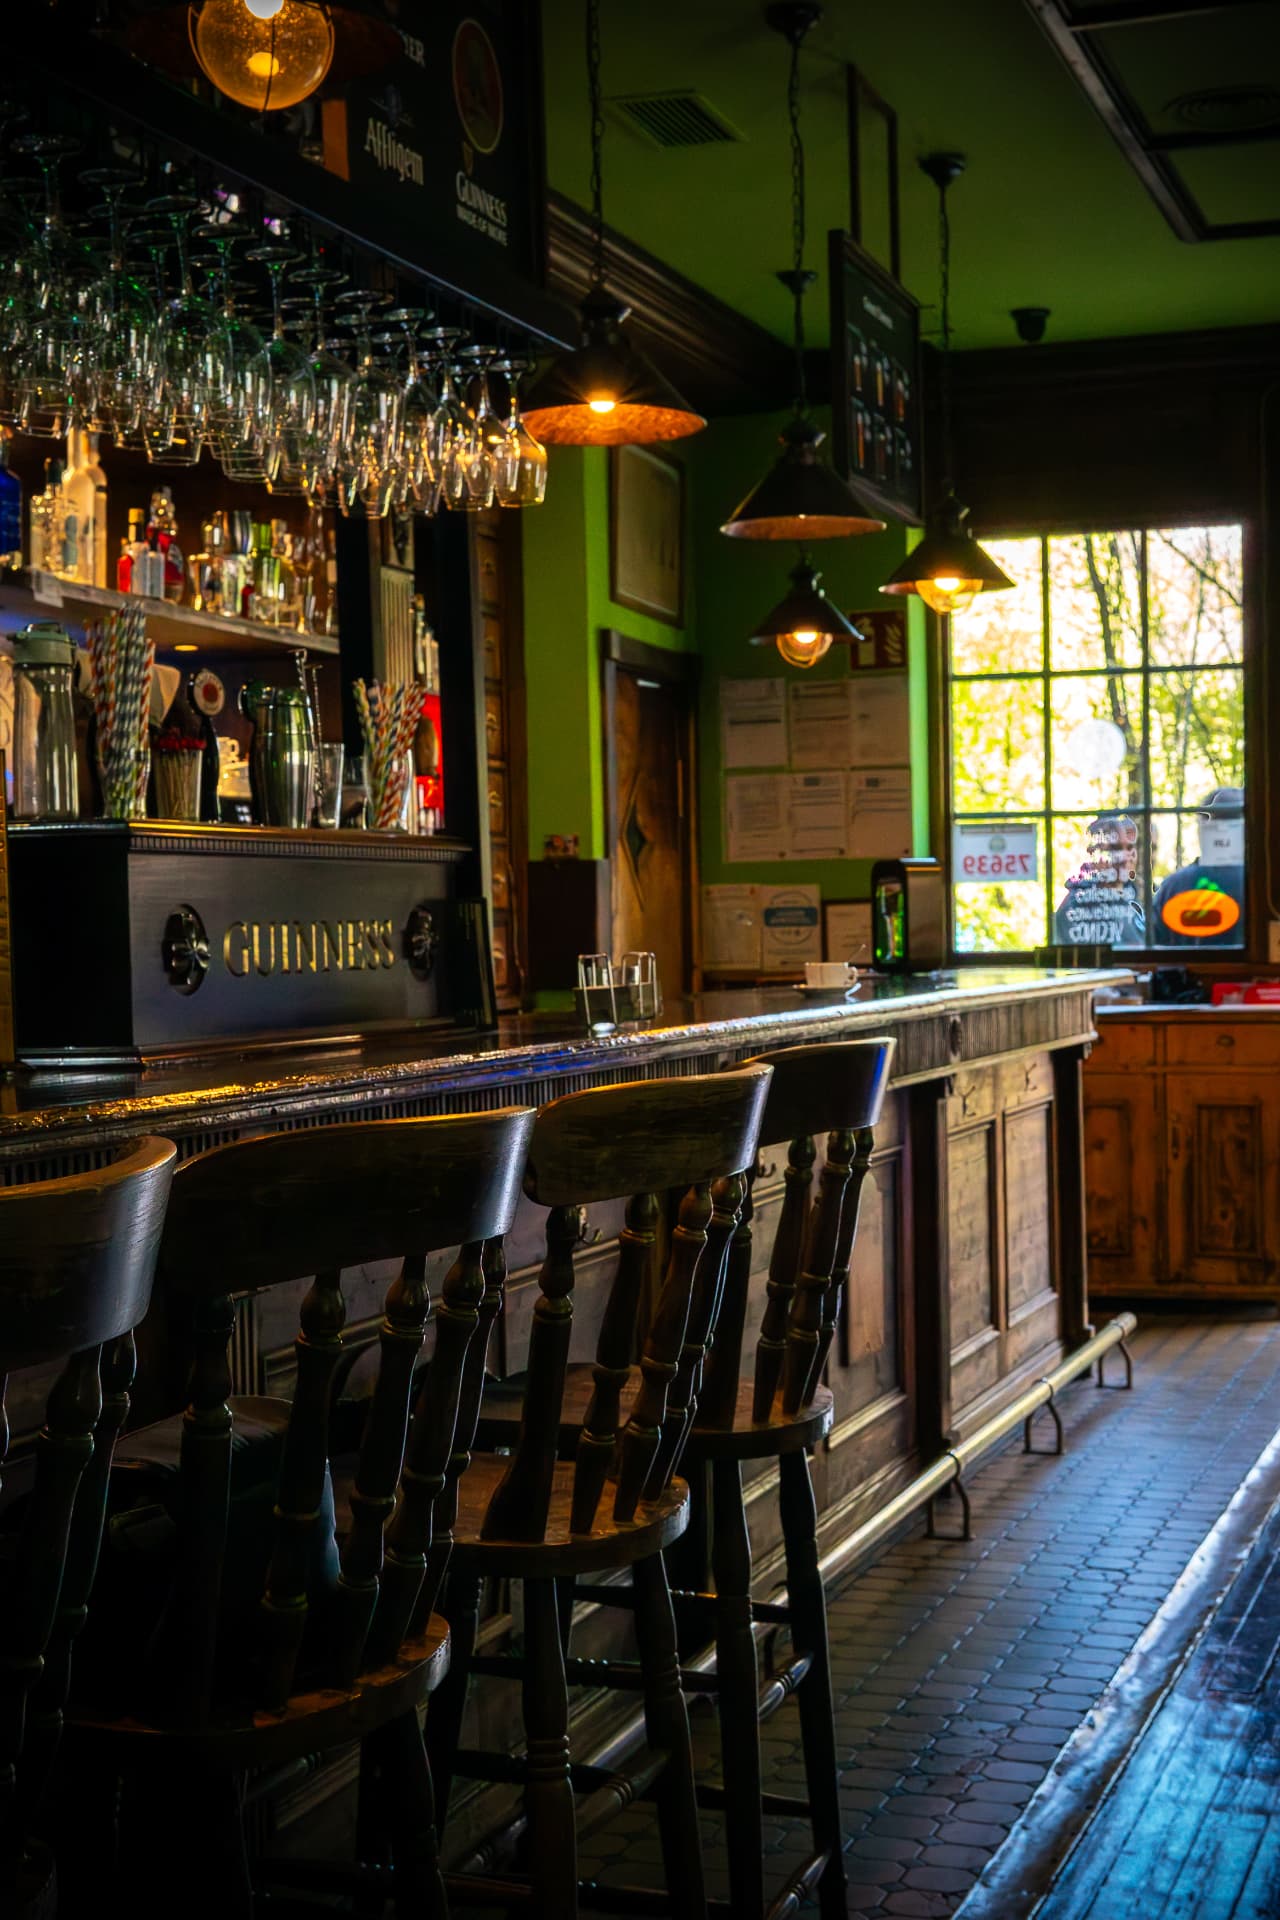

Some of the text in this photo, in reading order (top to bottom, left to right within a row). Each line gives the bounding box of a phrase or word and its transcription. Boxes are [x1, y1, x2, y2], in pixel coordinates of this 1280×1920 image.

[363, 117, 424, 186] Affligem
[455, 170, 508, 226] GUINNESS
[222, 918, 396, 977] GUINNESS
